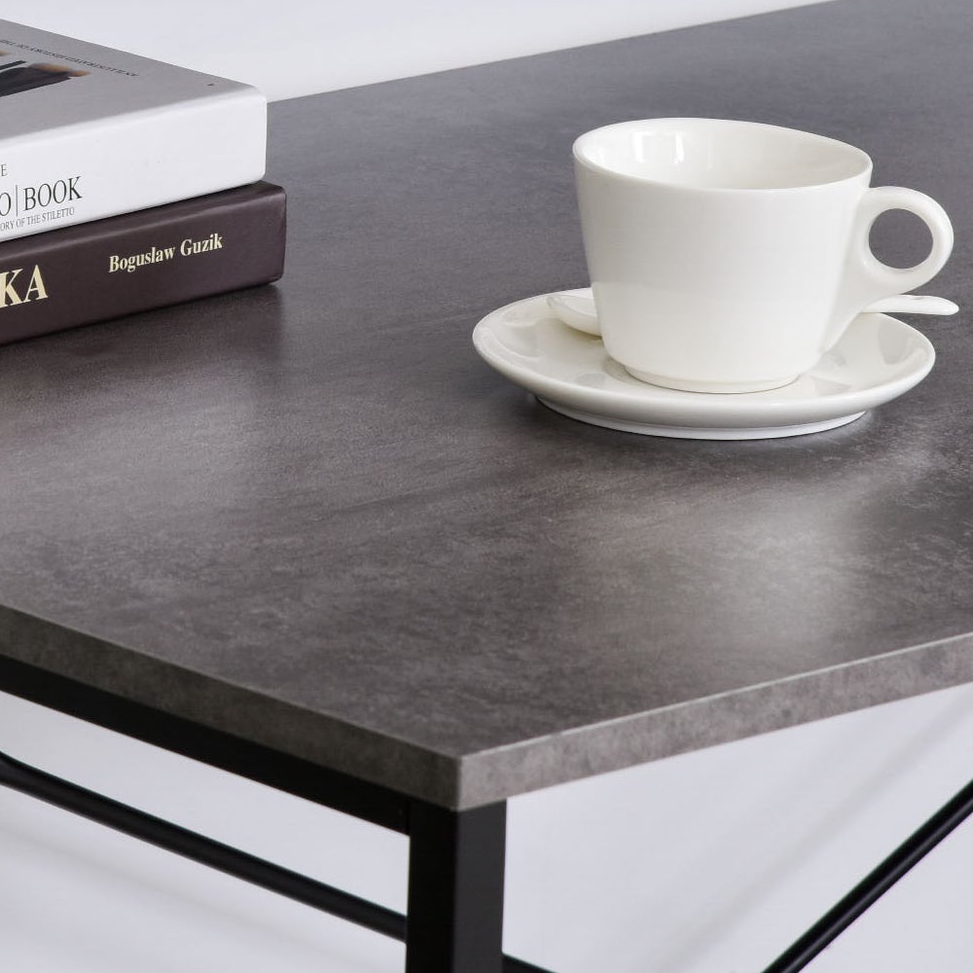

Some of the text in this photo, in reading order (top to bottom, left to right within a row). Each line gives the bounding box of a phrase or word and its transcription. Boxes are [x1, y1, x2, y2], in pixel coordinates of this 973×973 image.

[22, 176, 83, 211] BOOK
[15, 217, 26, 228] OF
[26, 214, 41, 226] THE
[41, 207, 76, 222] STILETTO
[108, 232, 223, 273] Boguslaw Guzik
